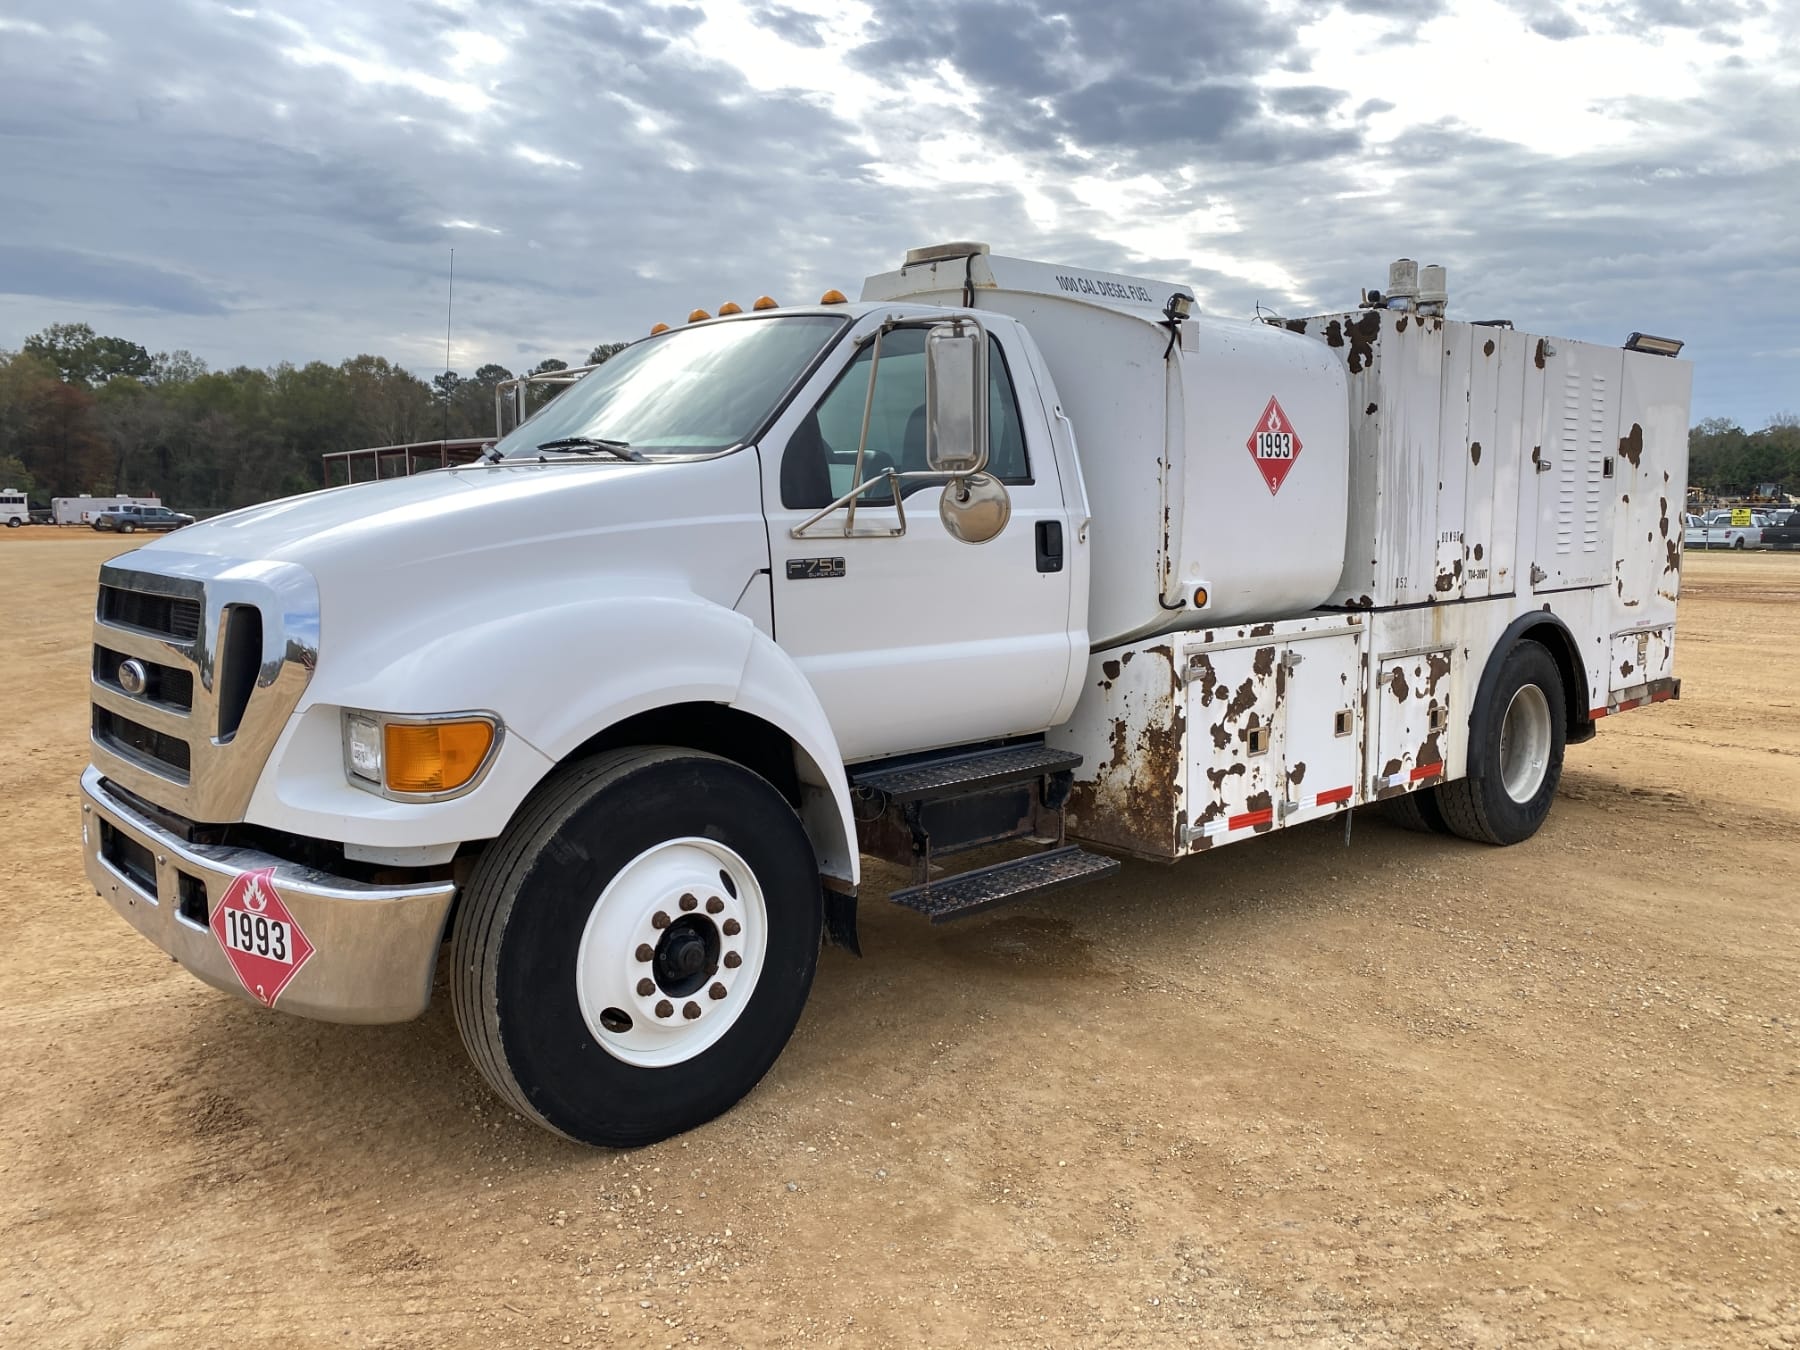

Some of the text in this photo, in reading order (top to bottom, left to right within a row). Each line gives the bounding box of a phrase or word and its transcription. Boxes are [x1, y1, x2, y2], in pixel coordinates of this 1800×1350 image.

[1055, 275, 1153, 302] 1000 GAL DIESEL FUEL
[1258, 433, 1290, 458] 1993
[1272, 477, 1277, 491] 3
[228, 910, 286, 961] 1993
